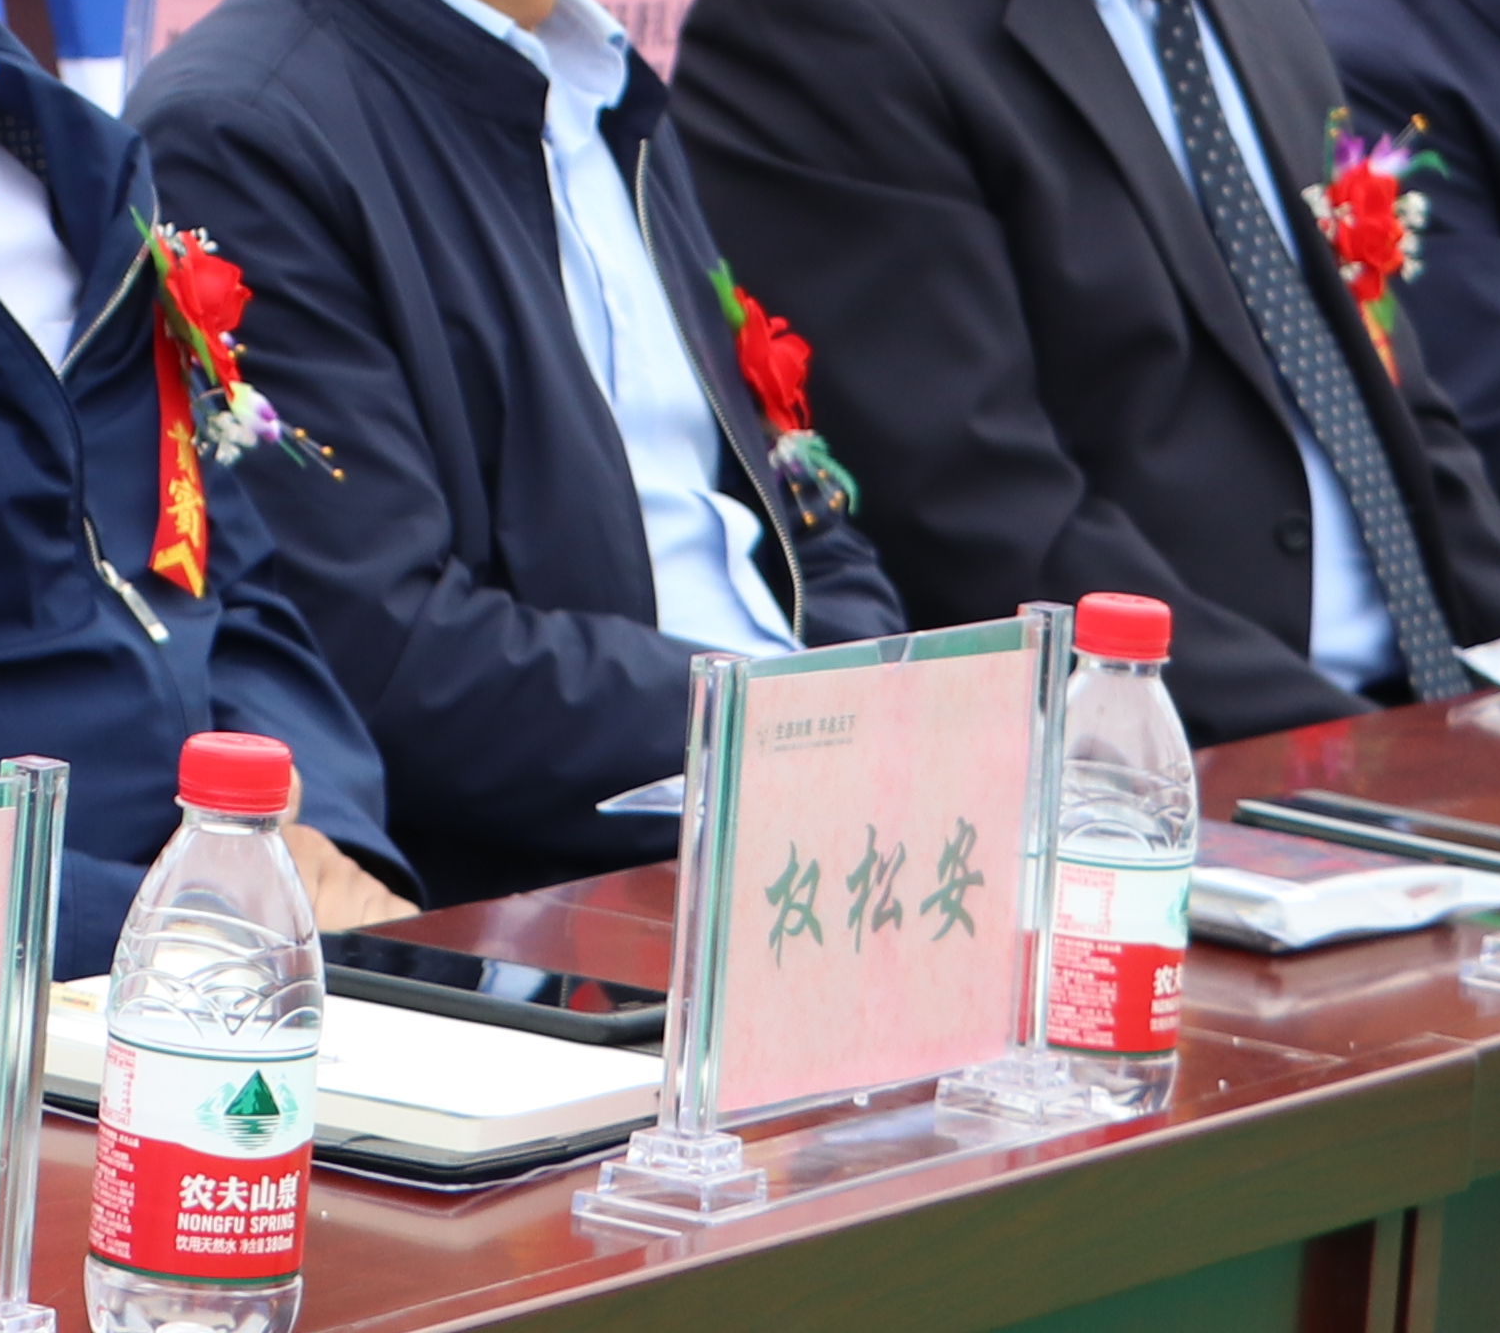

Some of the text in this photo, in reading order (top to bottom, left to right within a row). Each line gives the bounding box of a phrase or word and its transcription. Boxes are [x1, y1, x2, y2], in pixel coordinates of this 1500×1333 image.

[179, 1173, 299, 1212] 农夫山泉
[177, 1212, 295, 1233] NONGFU SPRING
[175, 1235, 238, 1254] 饮用天然水
